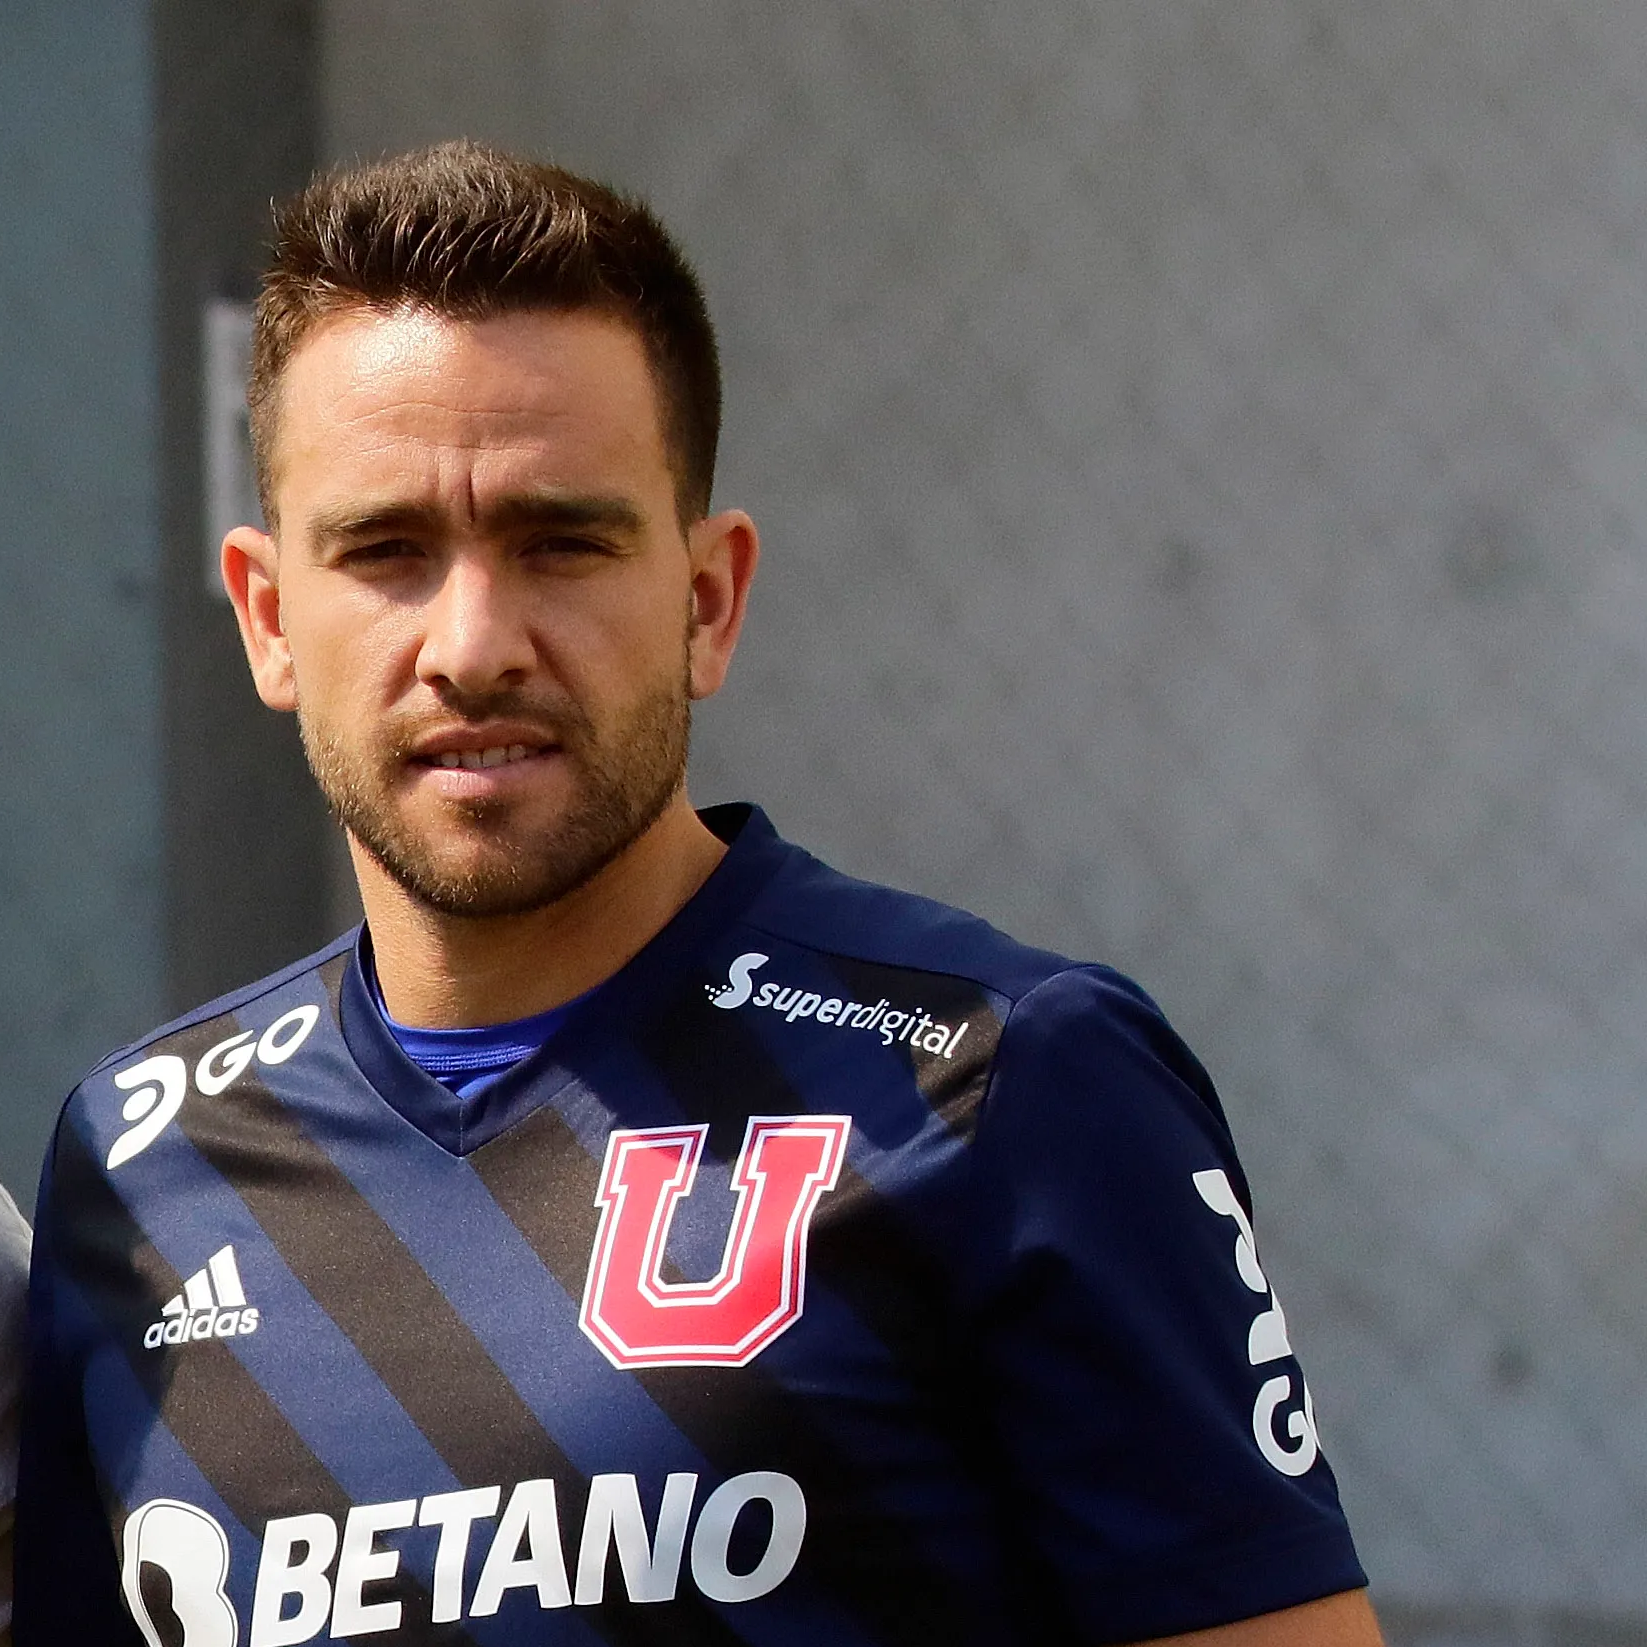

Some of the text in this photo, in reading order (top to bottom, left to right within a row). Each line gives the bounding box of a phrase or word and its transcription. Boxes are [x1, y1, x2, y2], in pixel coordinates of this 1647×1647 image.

[753, 982, 969, 1059] superdigital
[579, 1115, 853, 1370] U
[143, 1305, 260, 1350] adidas
